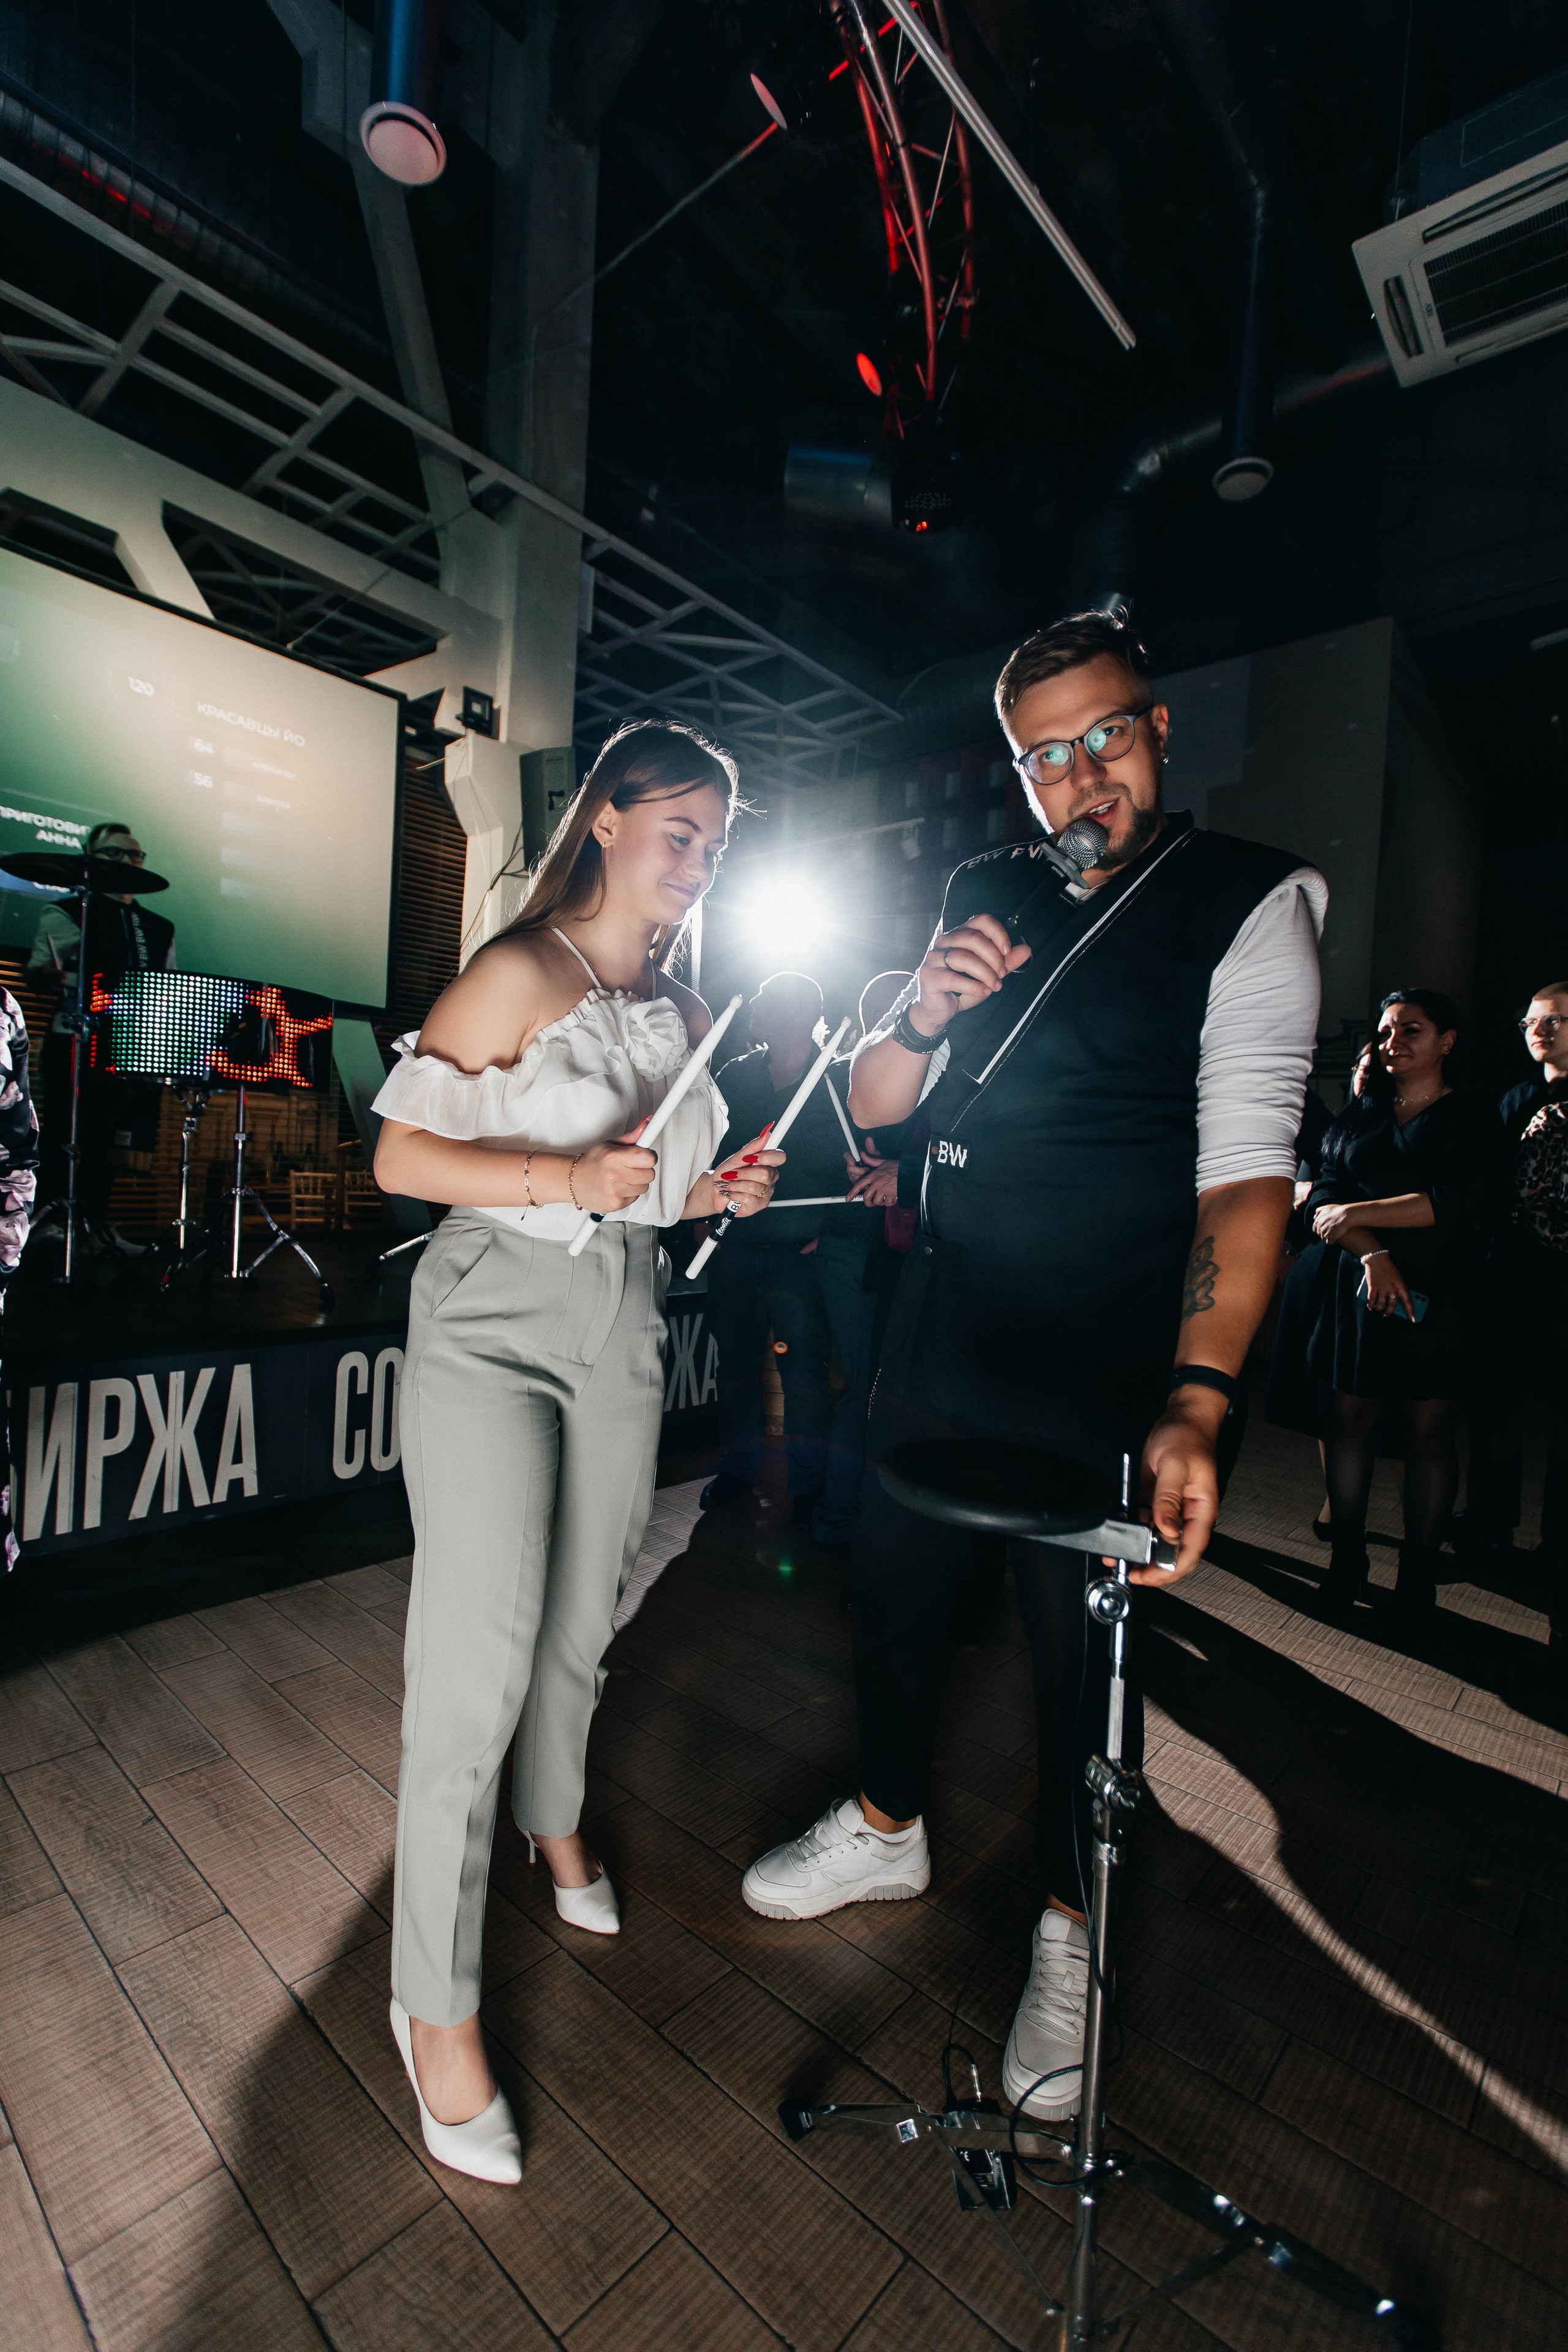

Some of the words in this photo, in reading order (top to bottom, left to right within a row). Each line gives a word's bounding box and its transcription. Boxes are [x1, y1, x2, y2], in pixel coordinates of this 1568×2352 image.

[197, 702, 281, 739] КРАСАВЦЫ
[36, 829, 82, 850] АННА
[1051, 865, 1066, 878] SHURE
[937, 1140, 968, 1168] BW
[663, 1313, 718, 1412] ЖА
[333, 1348, 405, 1479] СО
